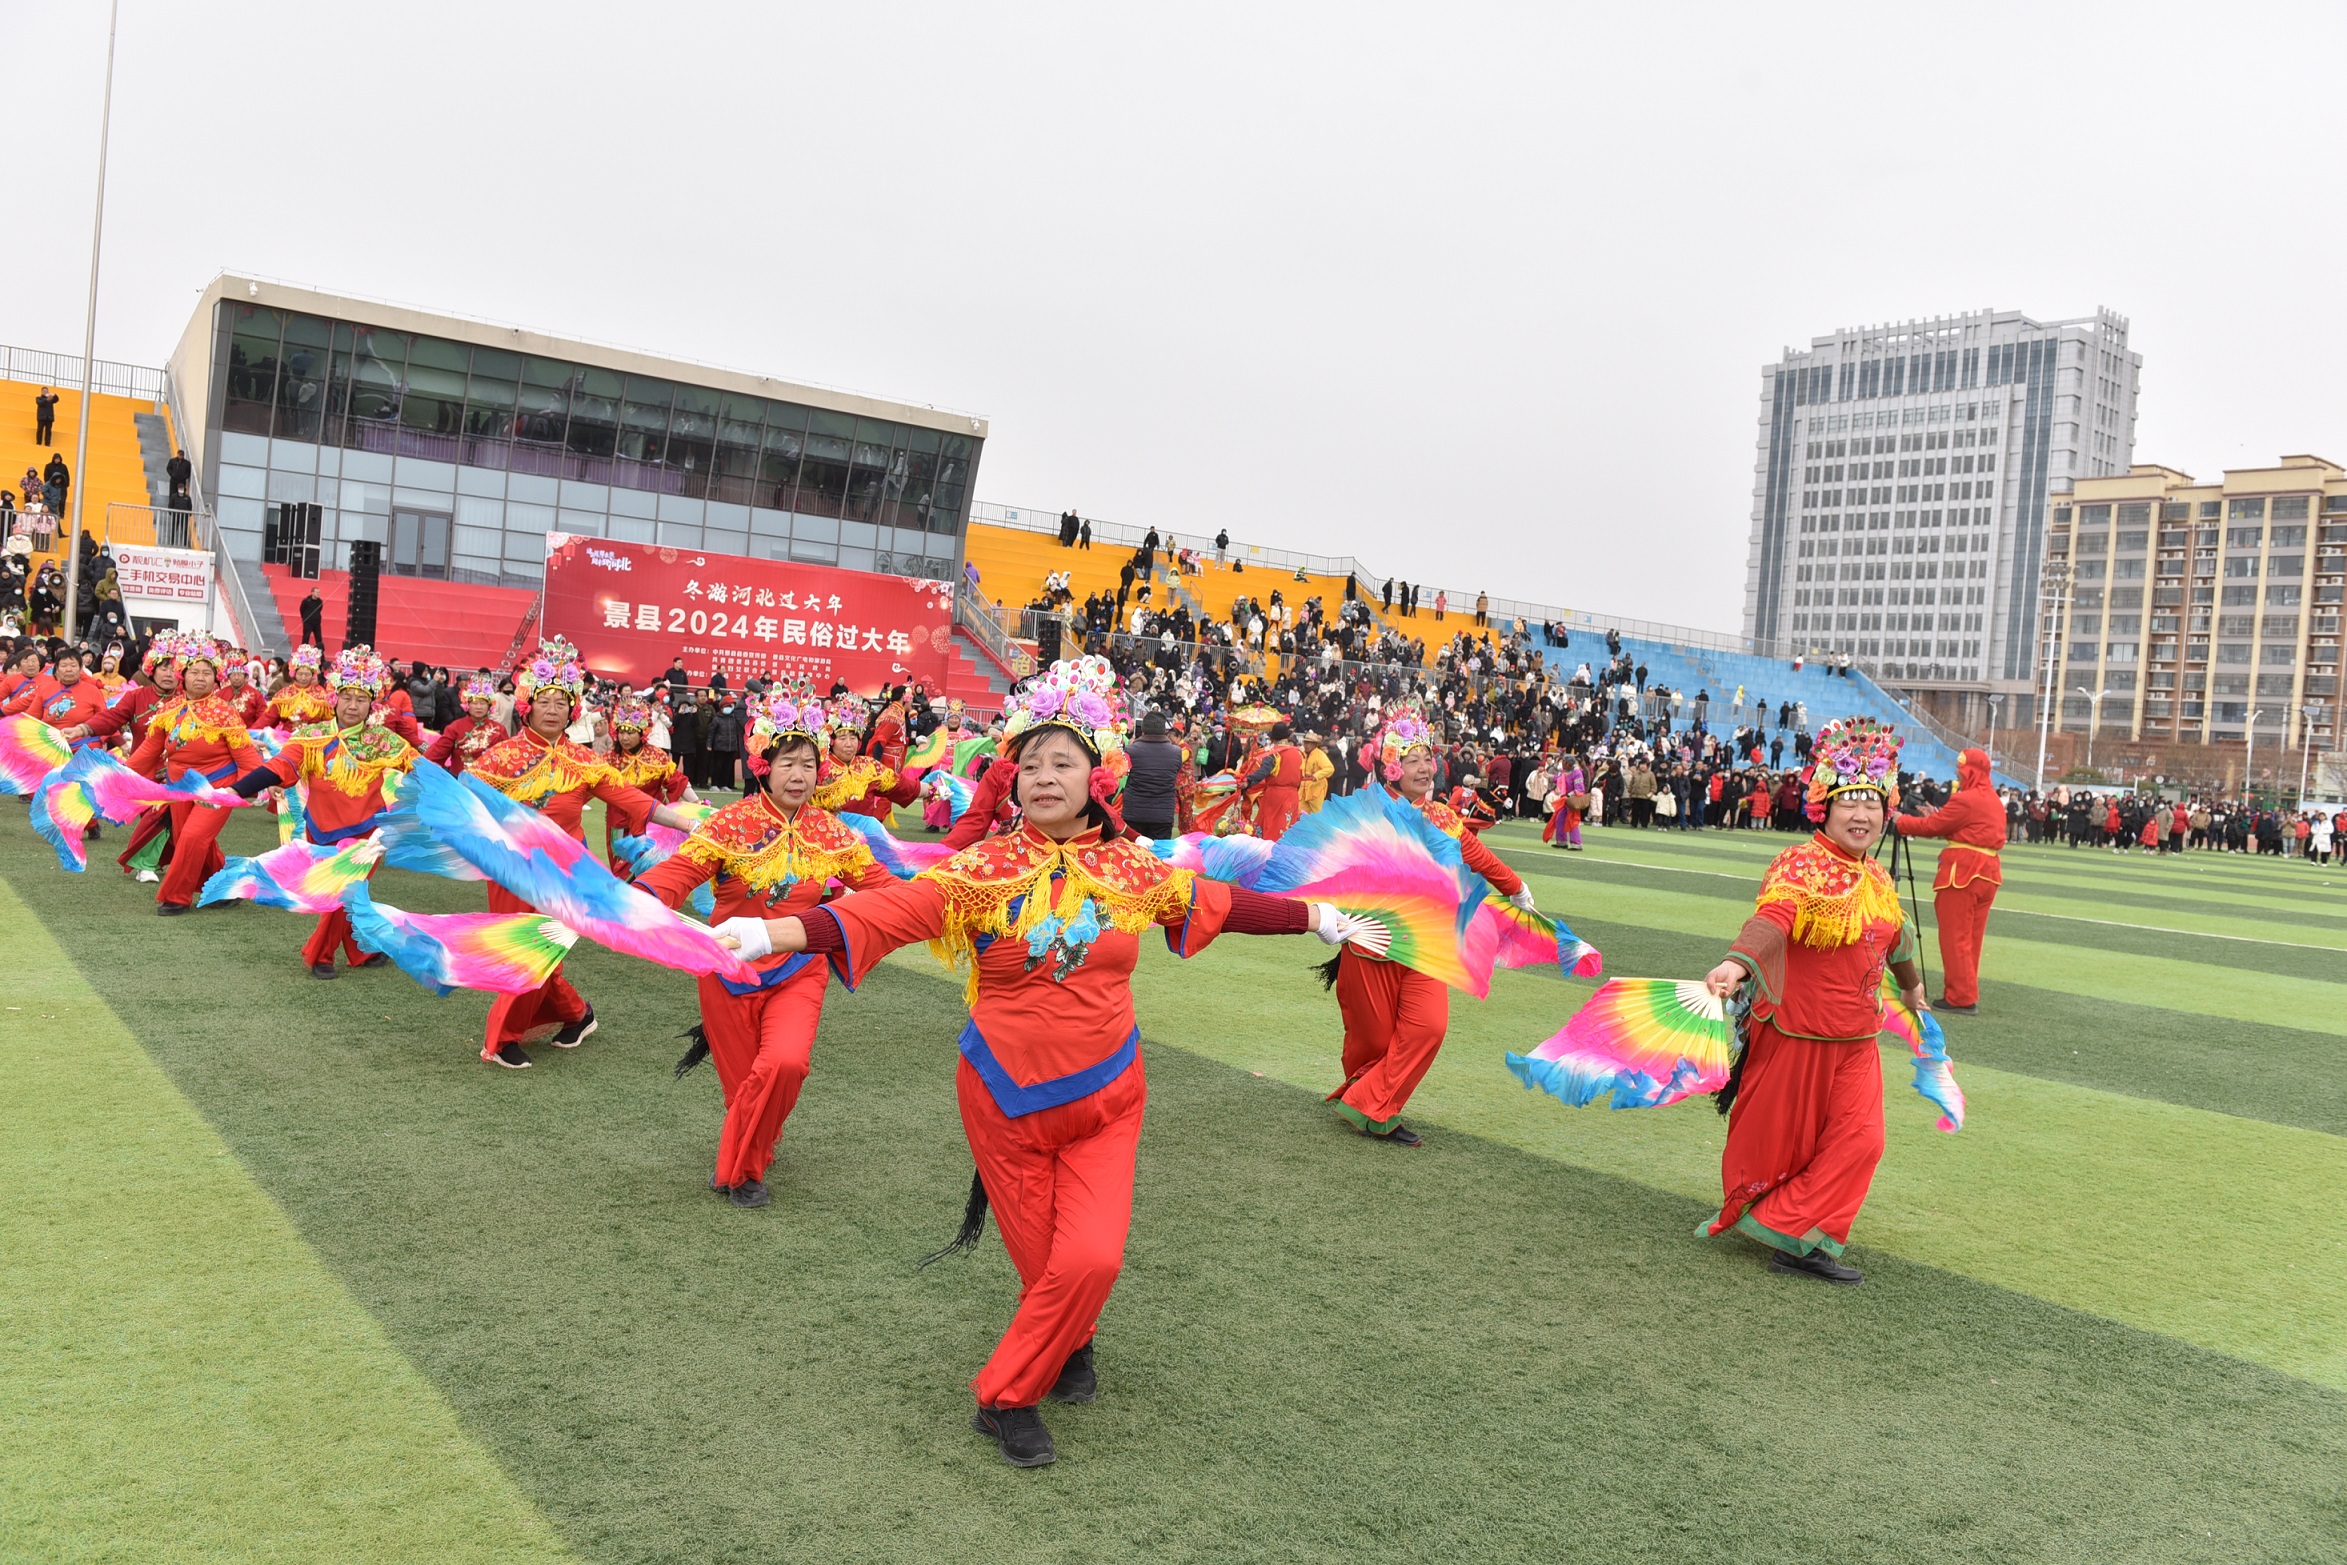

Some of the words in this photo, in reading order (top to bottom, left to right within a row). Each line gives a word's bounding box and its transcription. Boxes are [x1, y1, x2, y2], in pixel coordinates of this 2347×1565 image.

[118, 568, 205, 587] 二手机交易中心
[683, 579, 843, 617] 冬游河北过大年
[603, 601, 910, 656] 景县2024年民俗过大年
[686, 670, 708, 678] 办单位：
